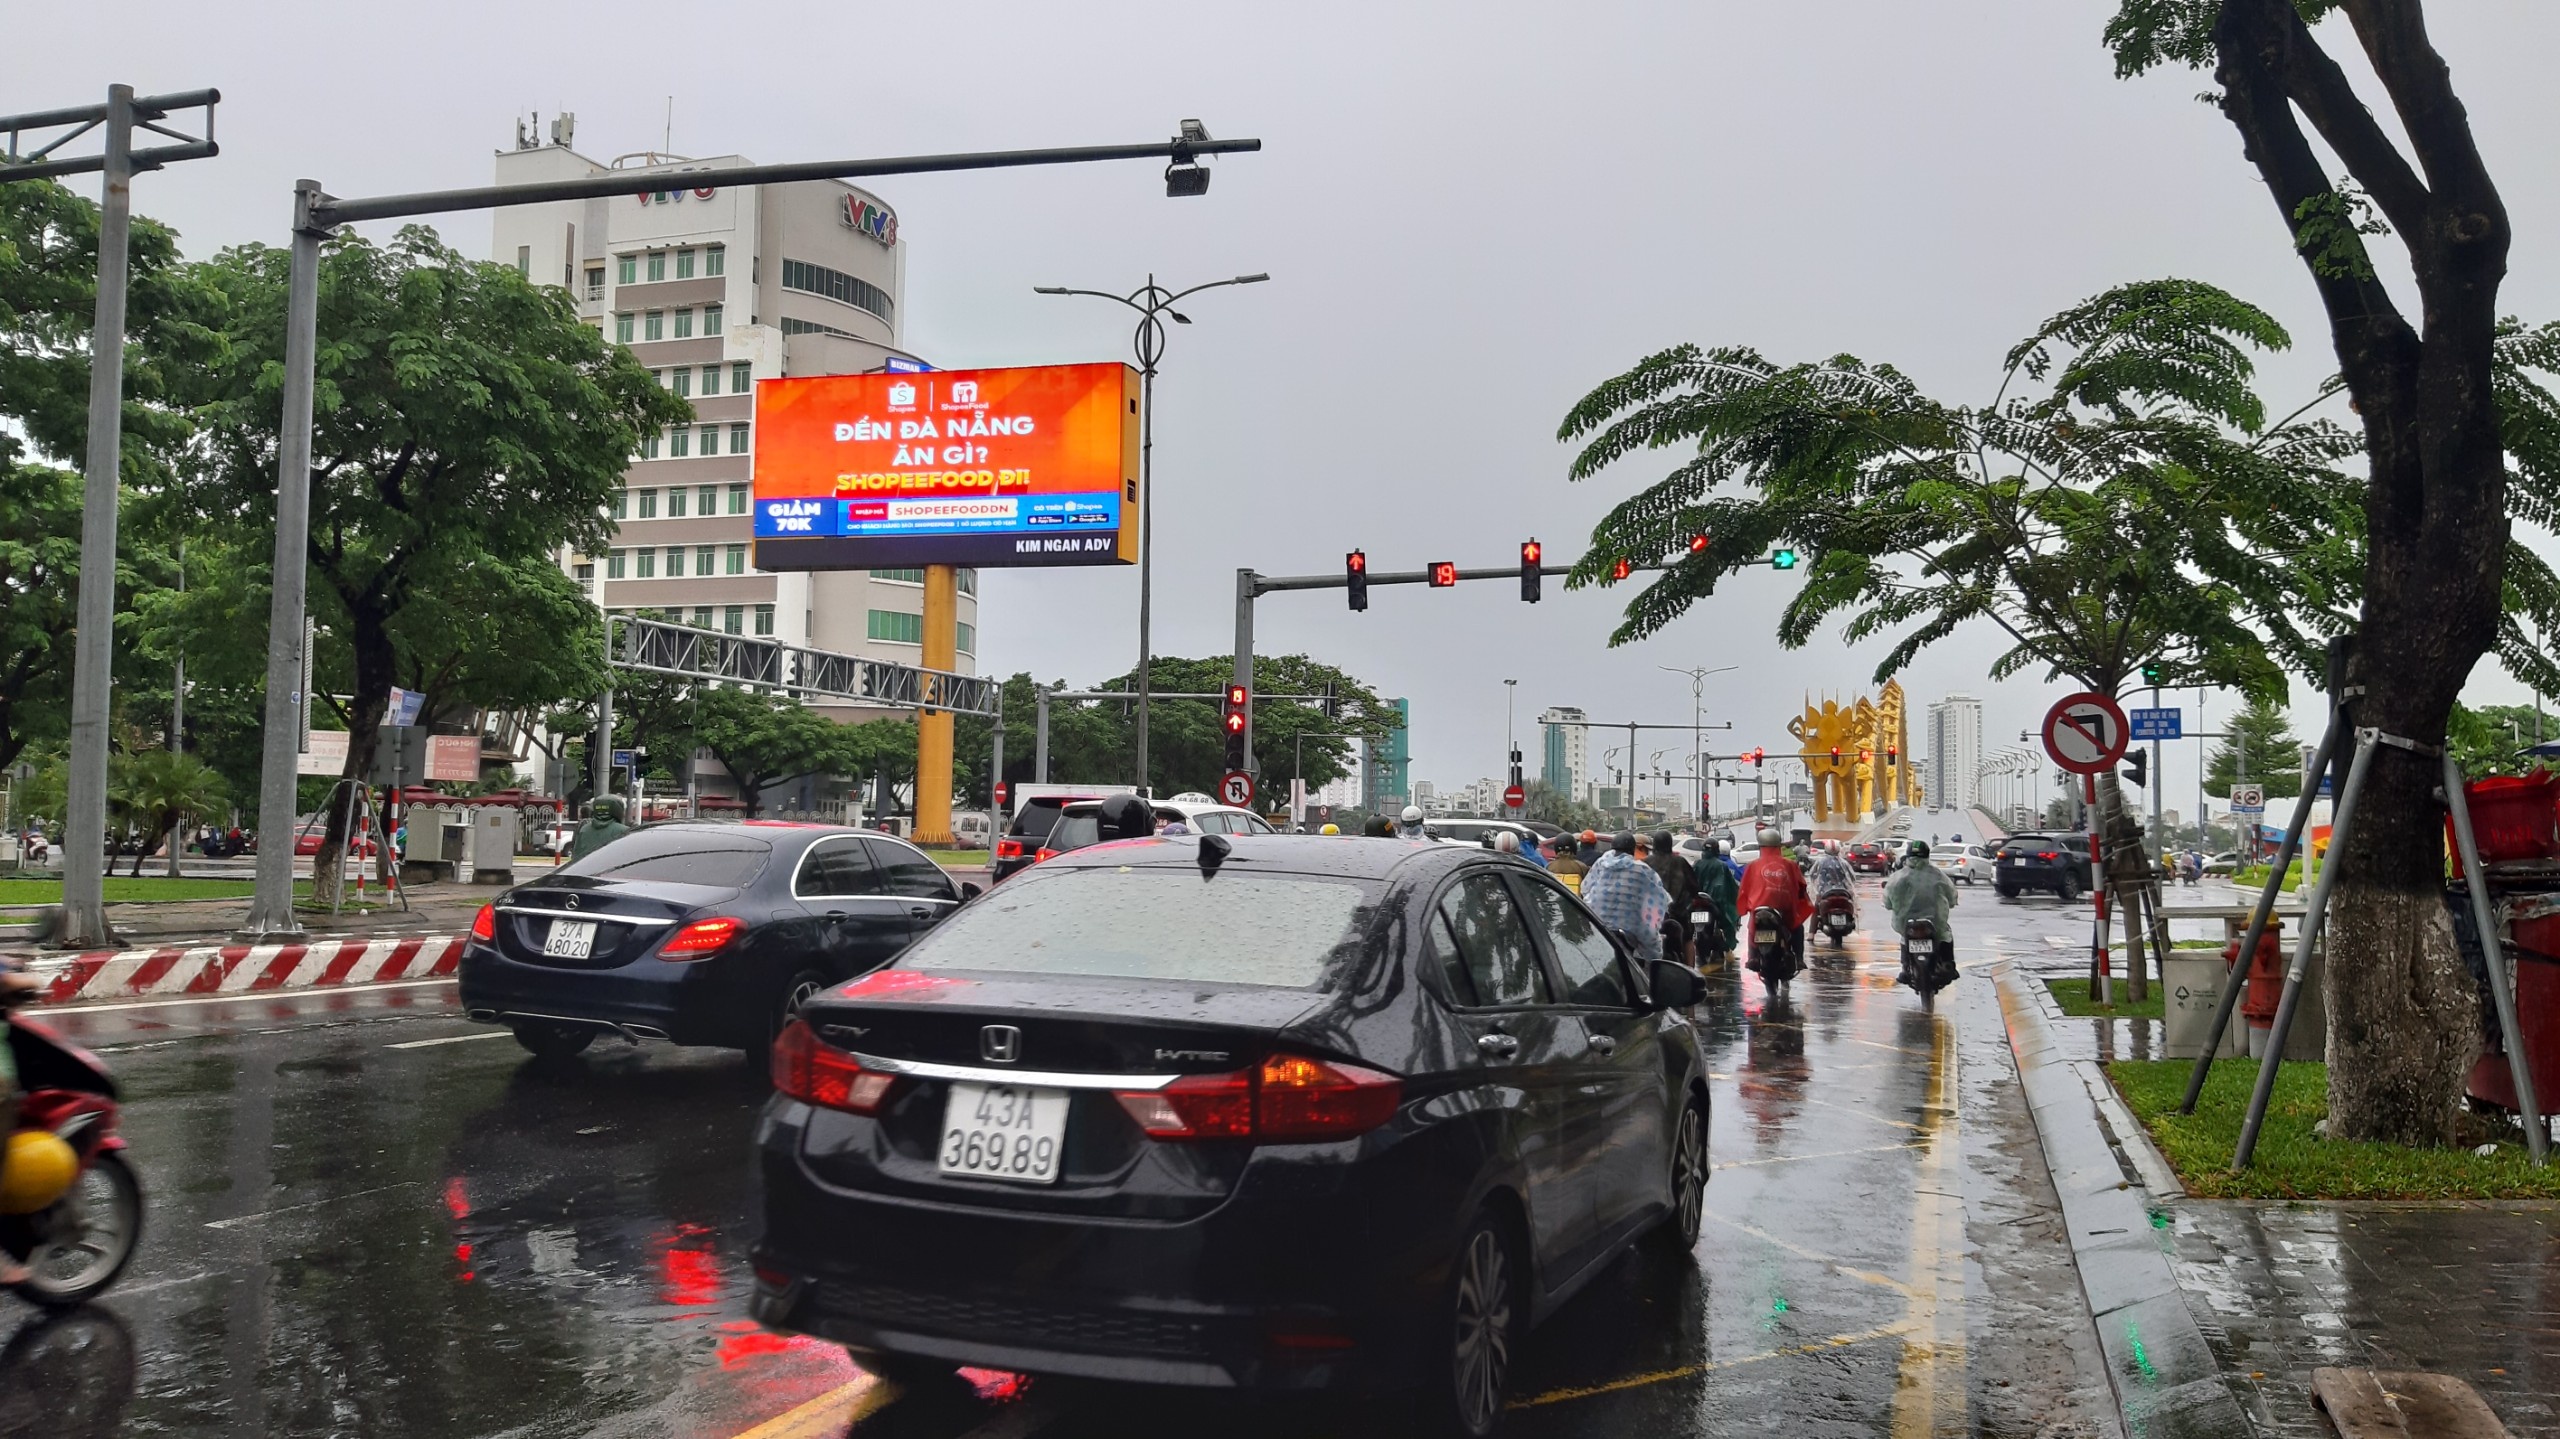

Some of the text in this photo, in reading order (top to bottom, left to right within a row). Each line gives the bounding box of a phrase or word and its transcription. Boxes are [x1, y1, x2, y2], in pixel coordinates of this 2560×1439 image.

[845, 192, 897, 248] VTV8
[888, 405, 916, 414] Shopee
[941, 402, 989, 412] ShopeeFood
[835, 411, 1035, 441] ĐẾN ĐÀ NẴNG
[892, 442, 988, 467] ĂN GÌ?
[837, 469, 1031, 490] SHOPEEFOOD ĐI!
[768, 500, 821, 517] GIẢM
[895, 505, 1009, 516] SHOPEEFOODDN
[776, 518, 812, 532] 70K
[1015, 538, 1112, 553] KIM NGAN ADV
[1437, 564, 1454, 585] 19
[559, 921, 584, 939] 37A
[975, 1085, 1034, 1130] 43A
[944, 1128, 1054, 1176] 369.89
